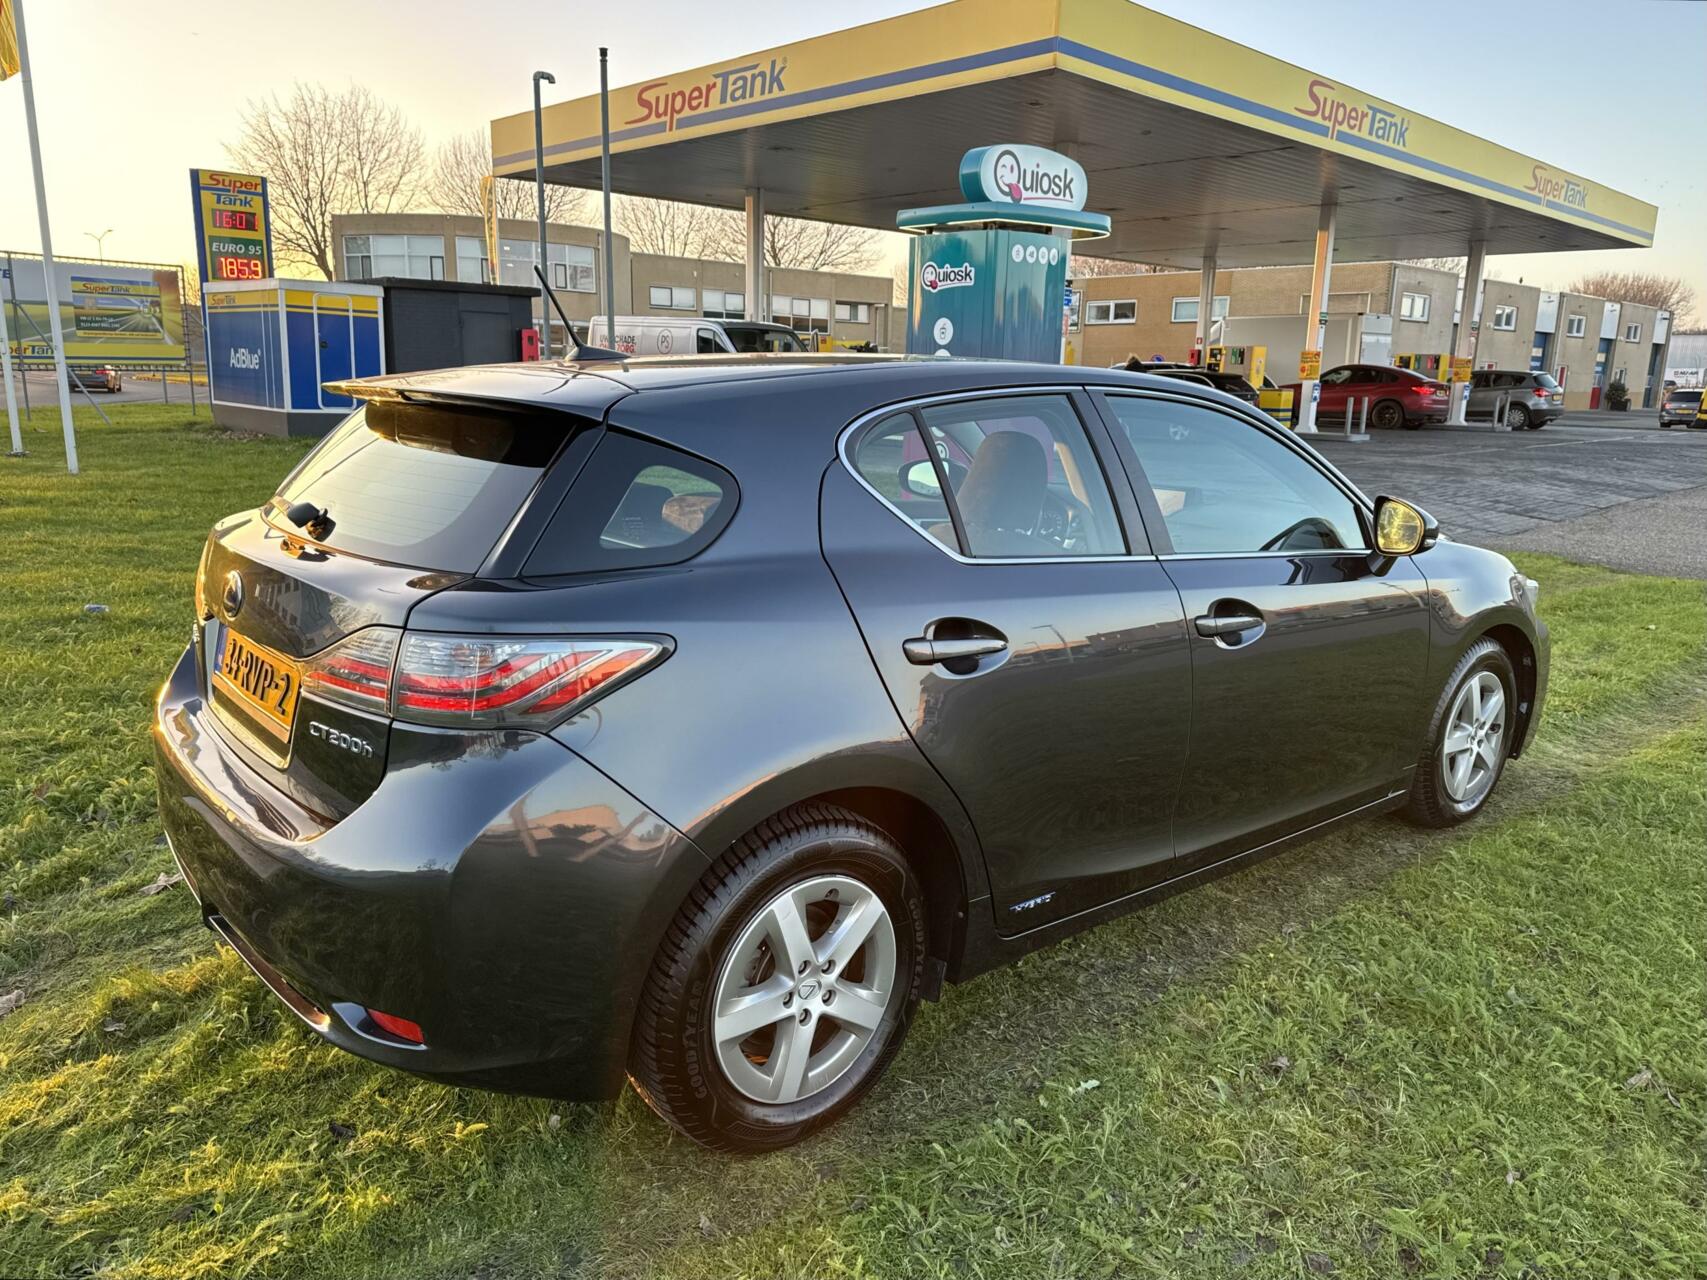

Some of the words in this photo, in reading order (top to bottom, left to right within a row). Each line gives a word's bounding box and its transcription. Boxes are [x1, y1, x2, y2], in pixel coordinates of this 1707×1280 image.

[624, 58, 788, 133] SuperTank
[1294, 79, 1409, 148] SuperTank
[208, 173, 261, 194] Super
[994, 149, 1074, 204] Quiosk
[1523, 164, 1588, 208] SuperTank
[211, 192, 254, 208] Tank
[215, 208, 259, 230] 16:01
[211, 242, 246, 254] EURO
[248, 245, 262, 255] 95
[220, 257, 262, 279] 185.9
[922, 262, 974, 290] Quiosk
[309, 721, 373, 758] CT200h
